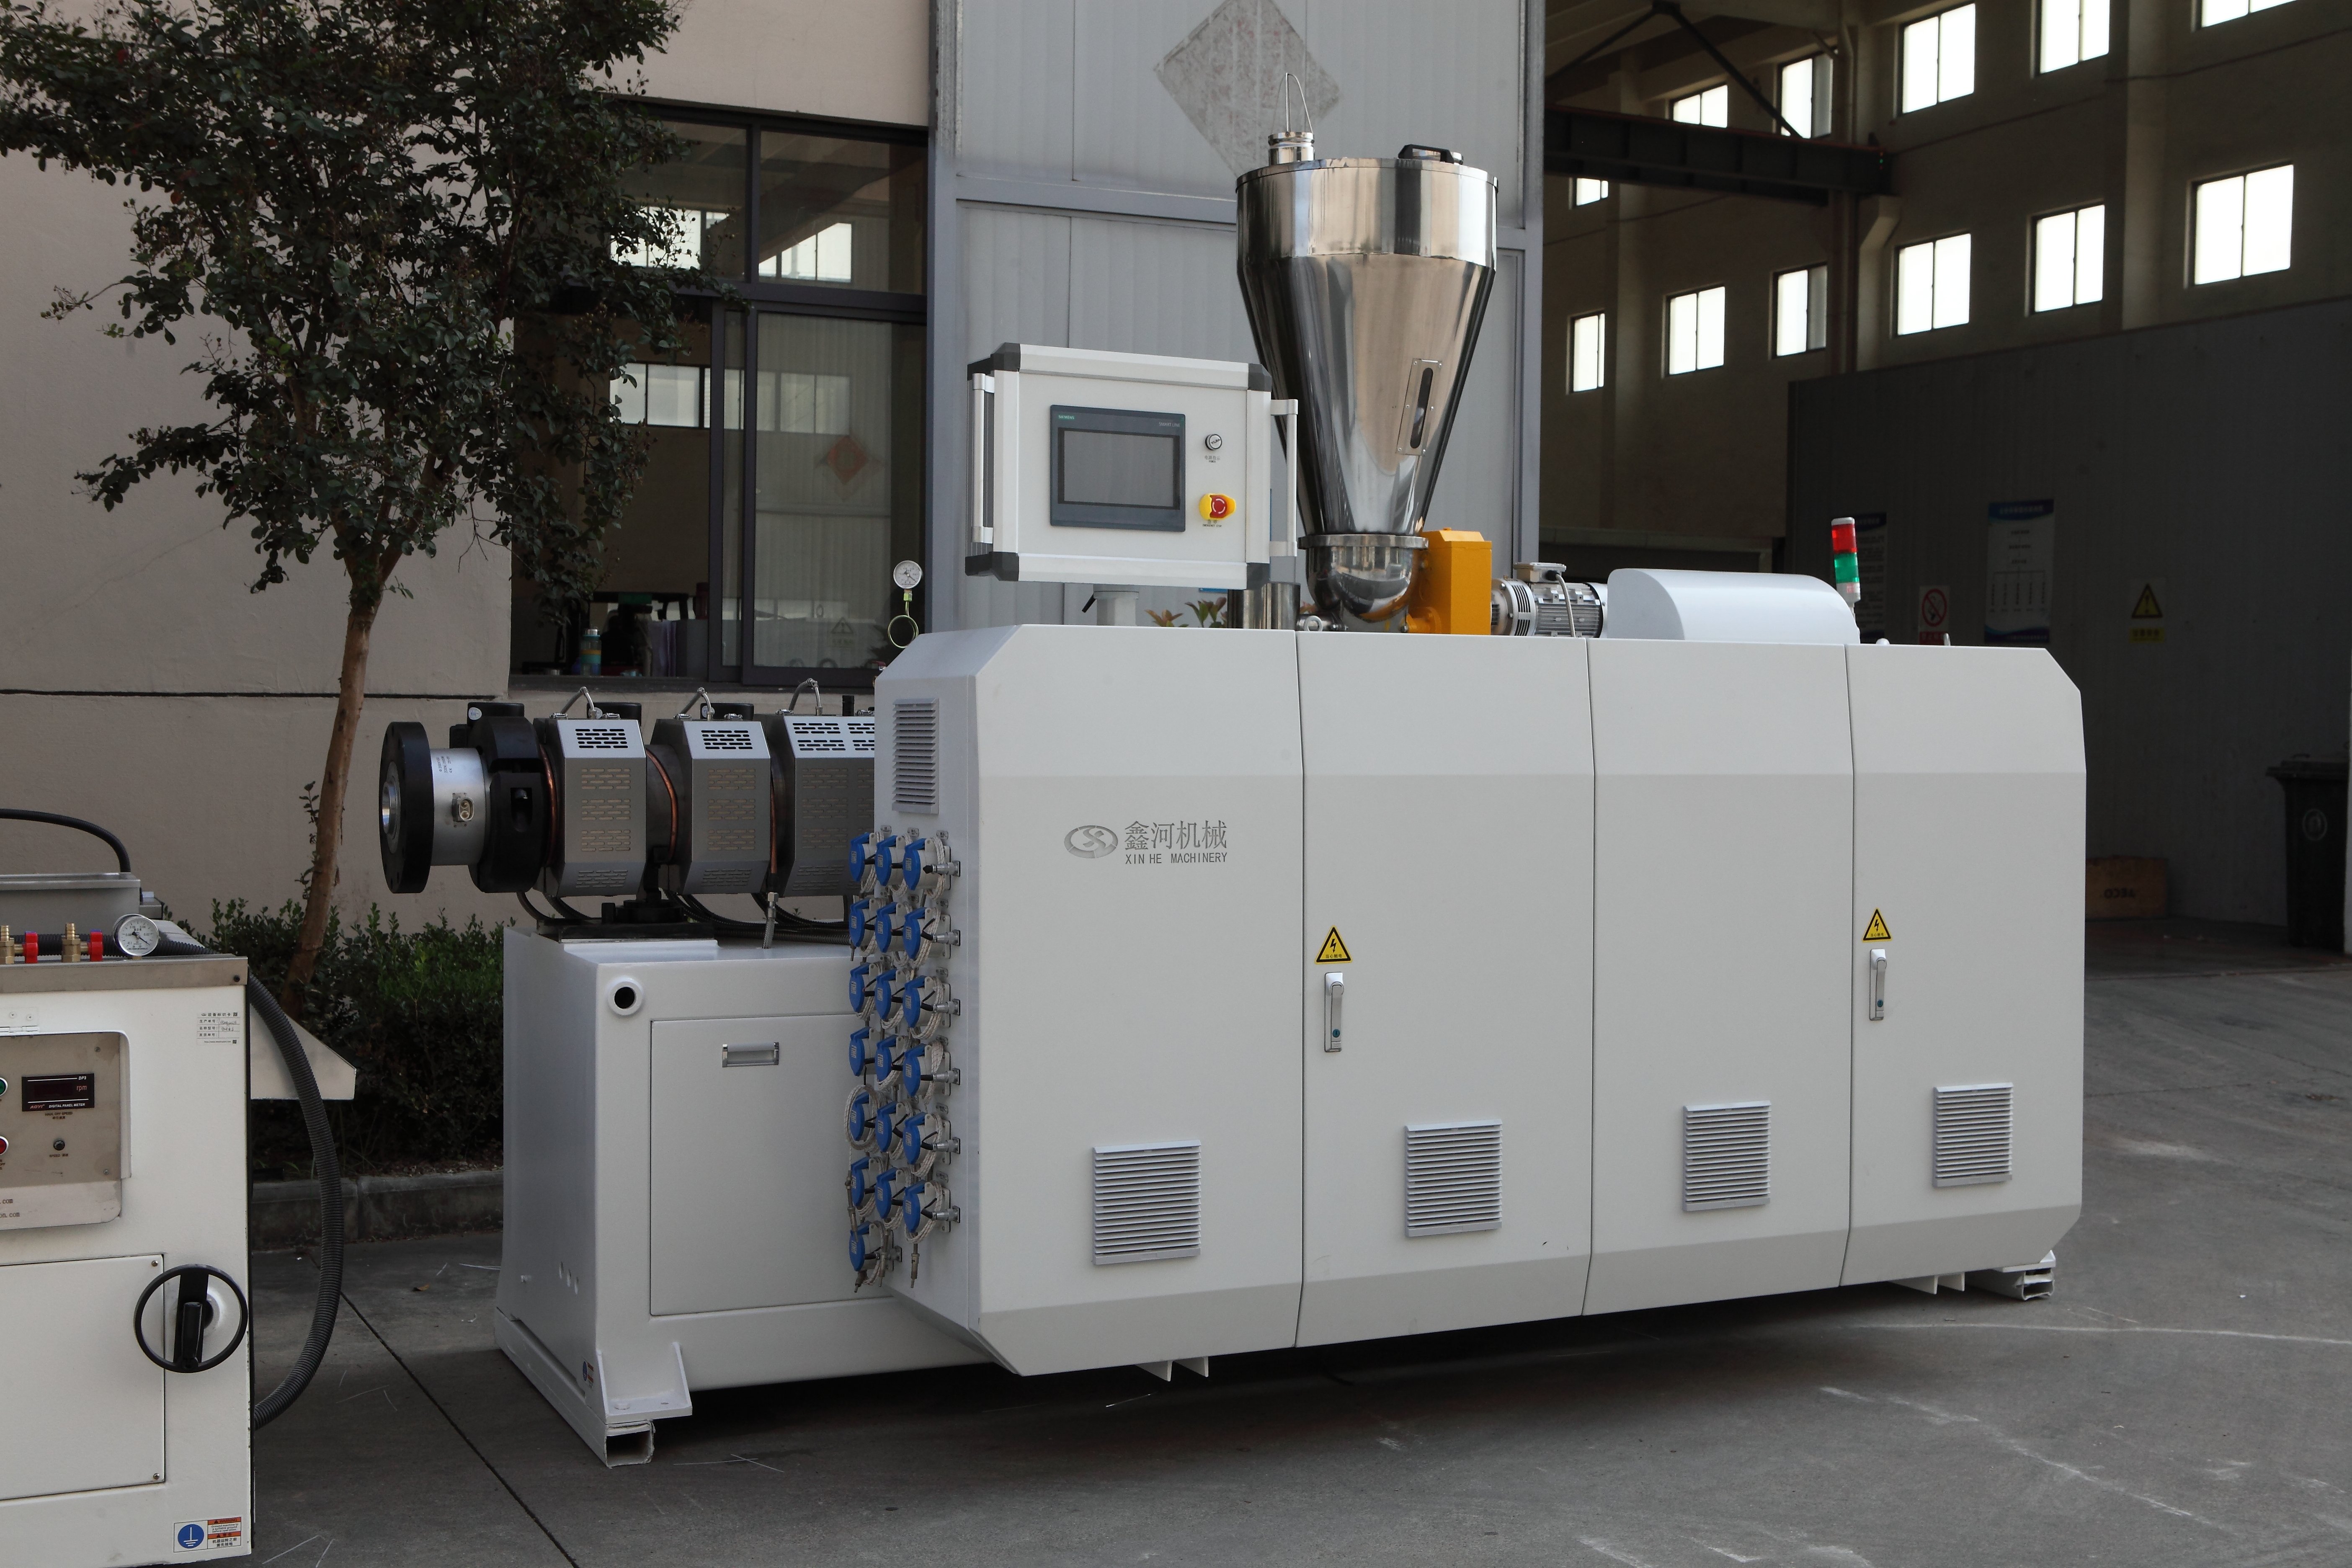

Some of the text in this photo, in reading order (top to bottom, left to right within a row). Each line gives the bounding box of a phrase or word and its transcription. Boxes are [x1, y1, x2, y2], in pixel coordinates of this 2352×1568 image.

[1124, 820, 1228, 850] 鑫河机械
[1125, 852, 1227, 864] XIN HE MACHINERY
